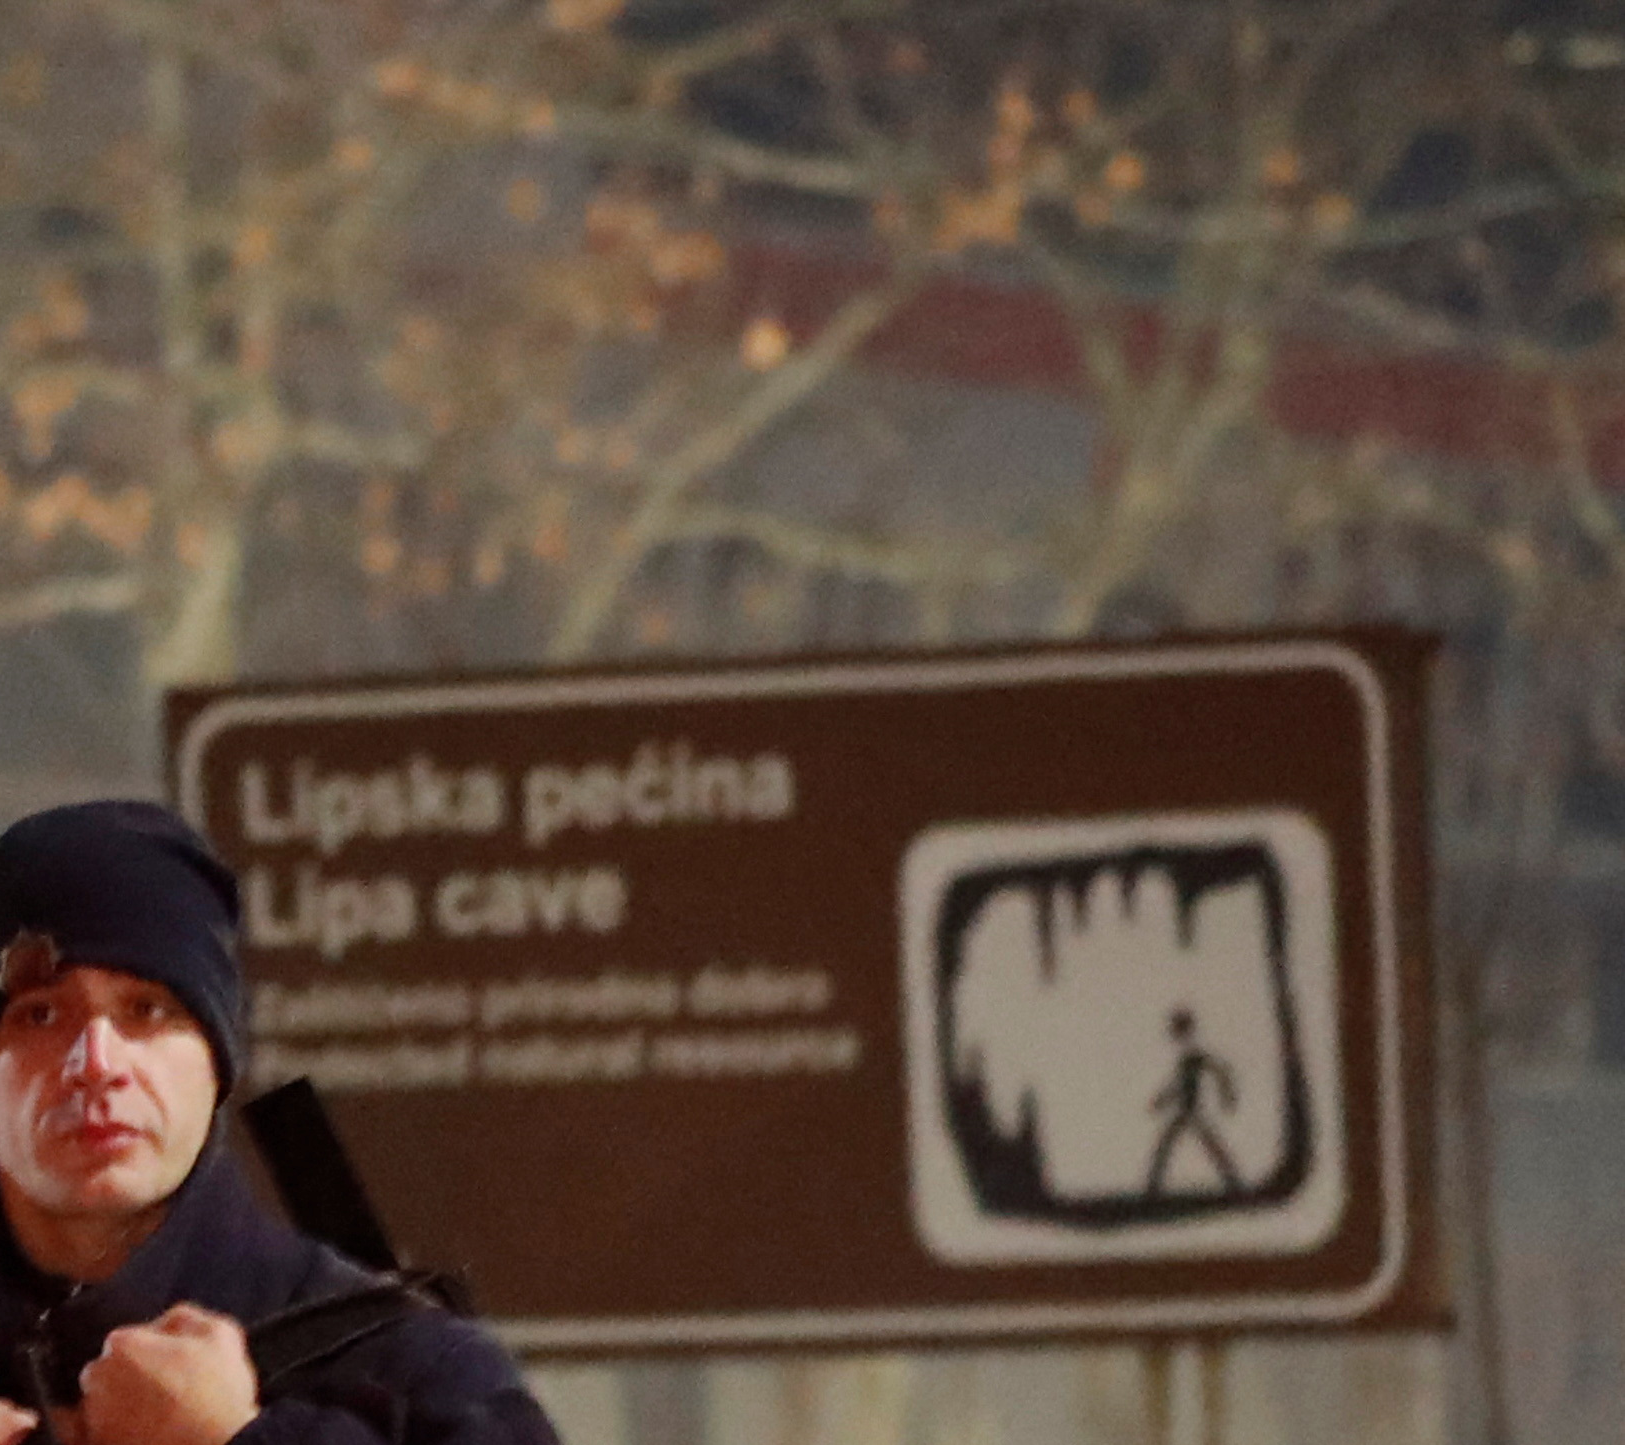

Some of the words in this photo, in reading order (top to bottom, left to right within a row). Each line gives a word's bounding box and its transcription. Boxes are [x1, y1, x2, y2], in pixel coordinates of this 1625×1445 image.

[239, 752, 507, 856] Lipska
[243, 864, 417, 960] Lipa
[435, 864, 626, 938] cave
